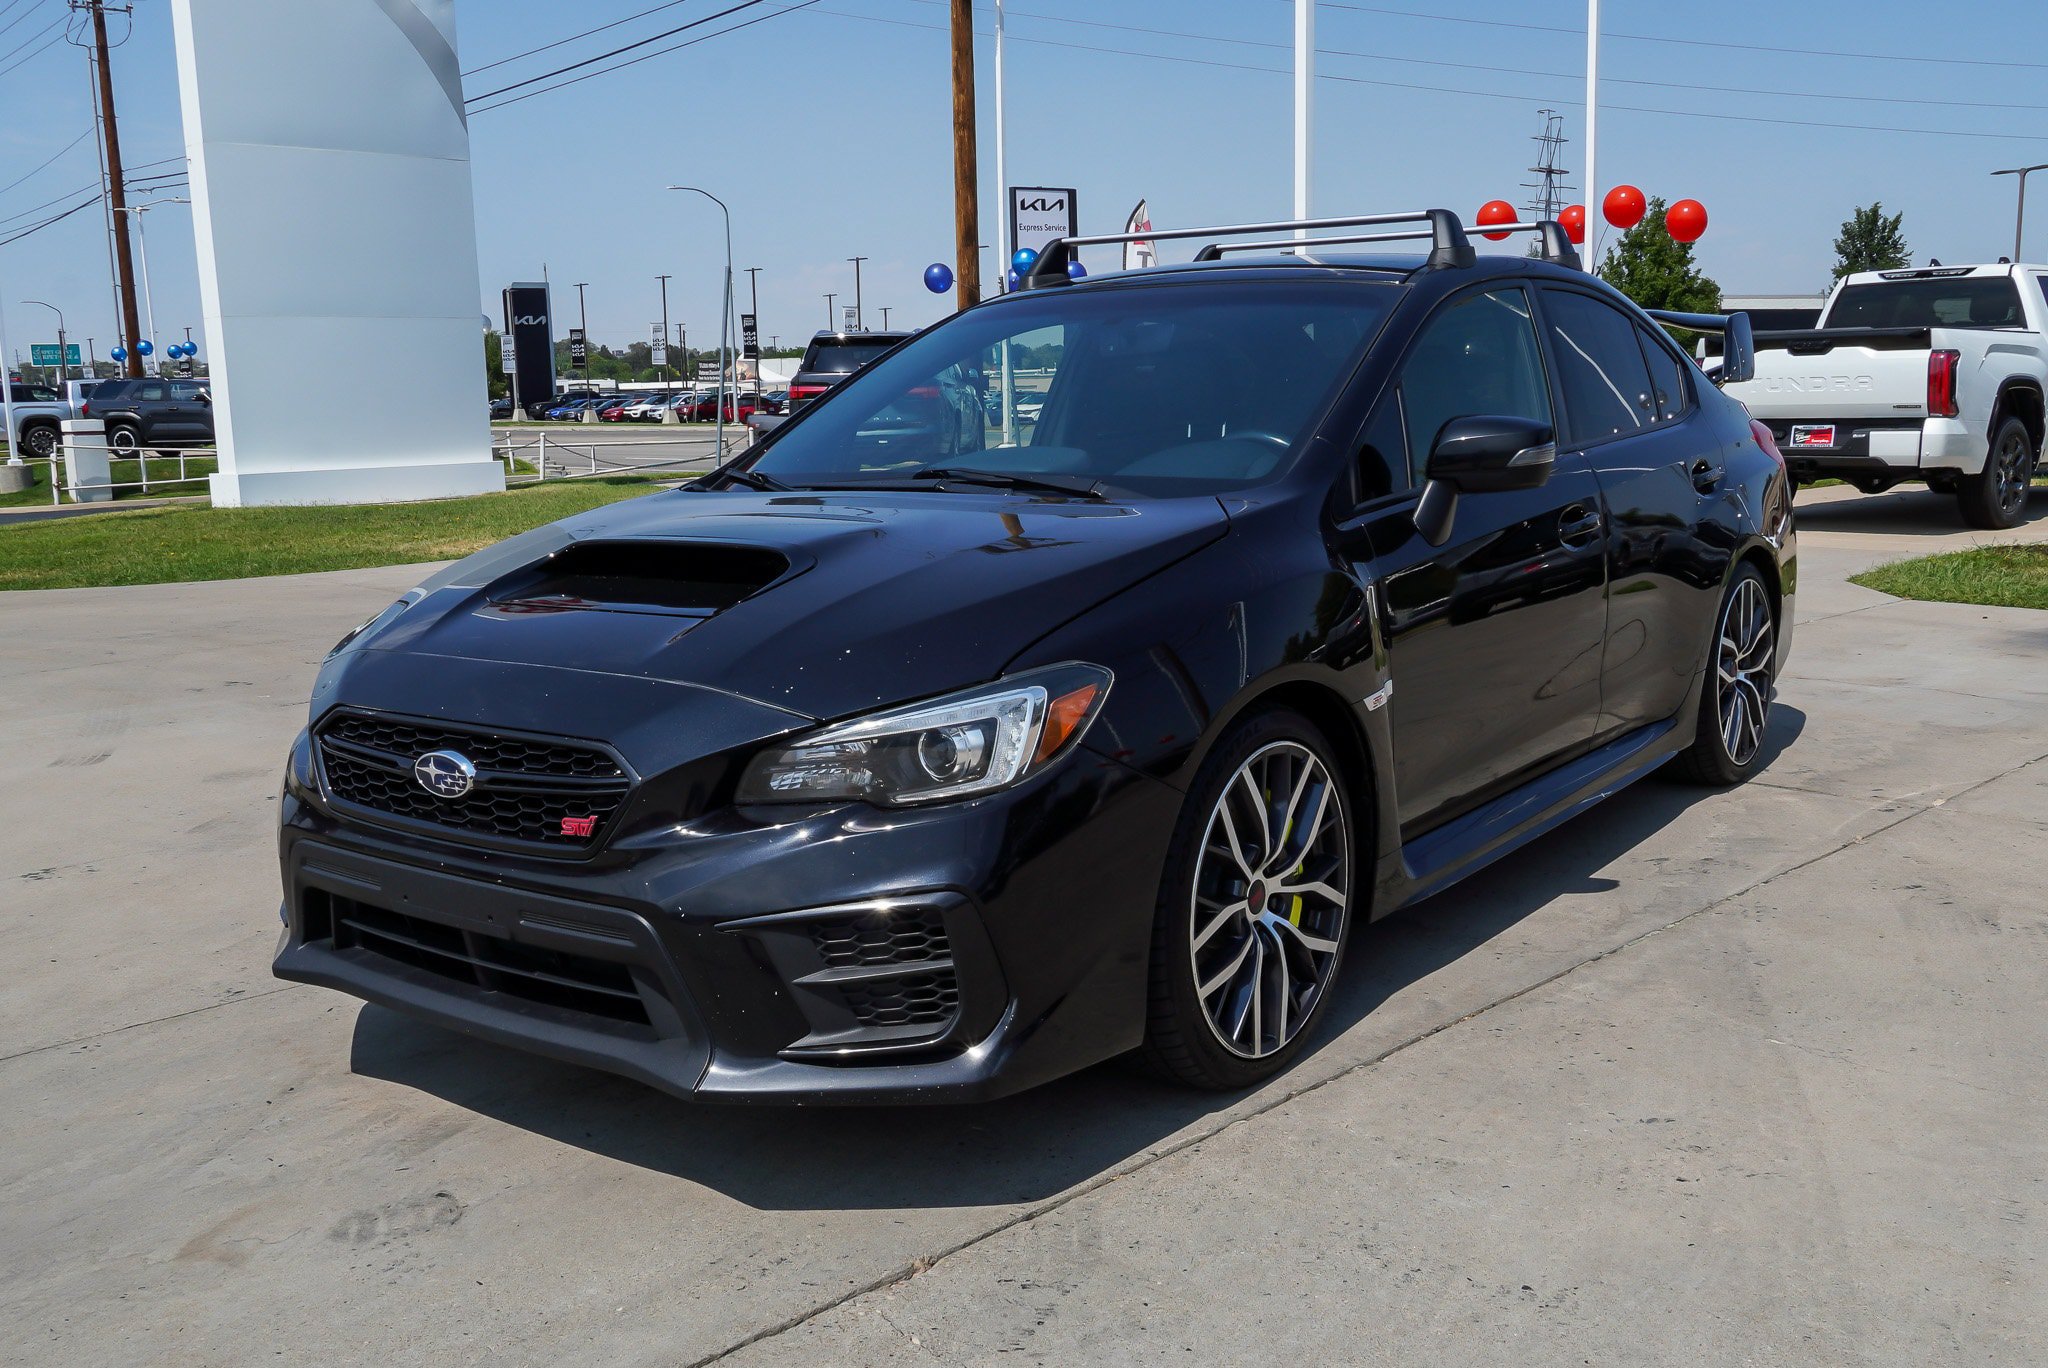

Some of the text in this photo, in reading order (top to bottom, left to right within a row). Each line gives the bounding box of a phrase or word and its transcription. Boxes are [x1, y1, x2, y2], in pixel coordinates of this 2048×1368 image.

[1020, 197, 1064, 212] KIA
[1019, 223, 1067, 232] Express Service
[514, 315, 547, 325] KIA
